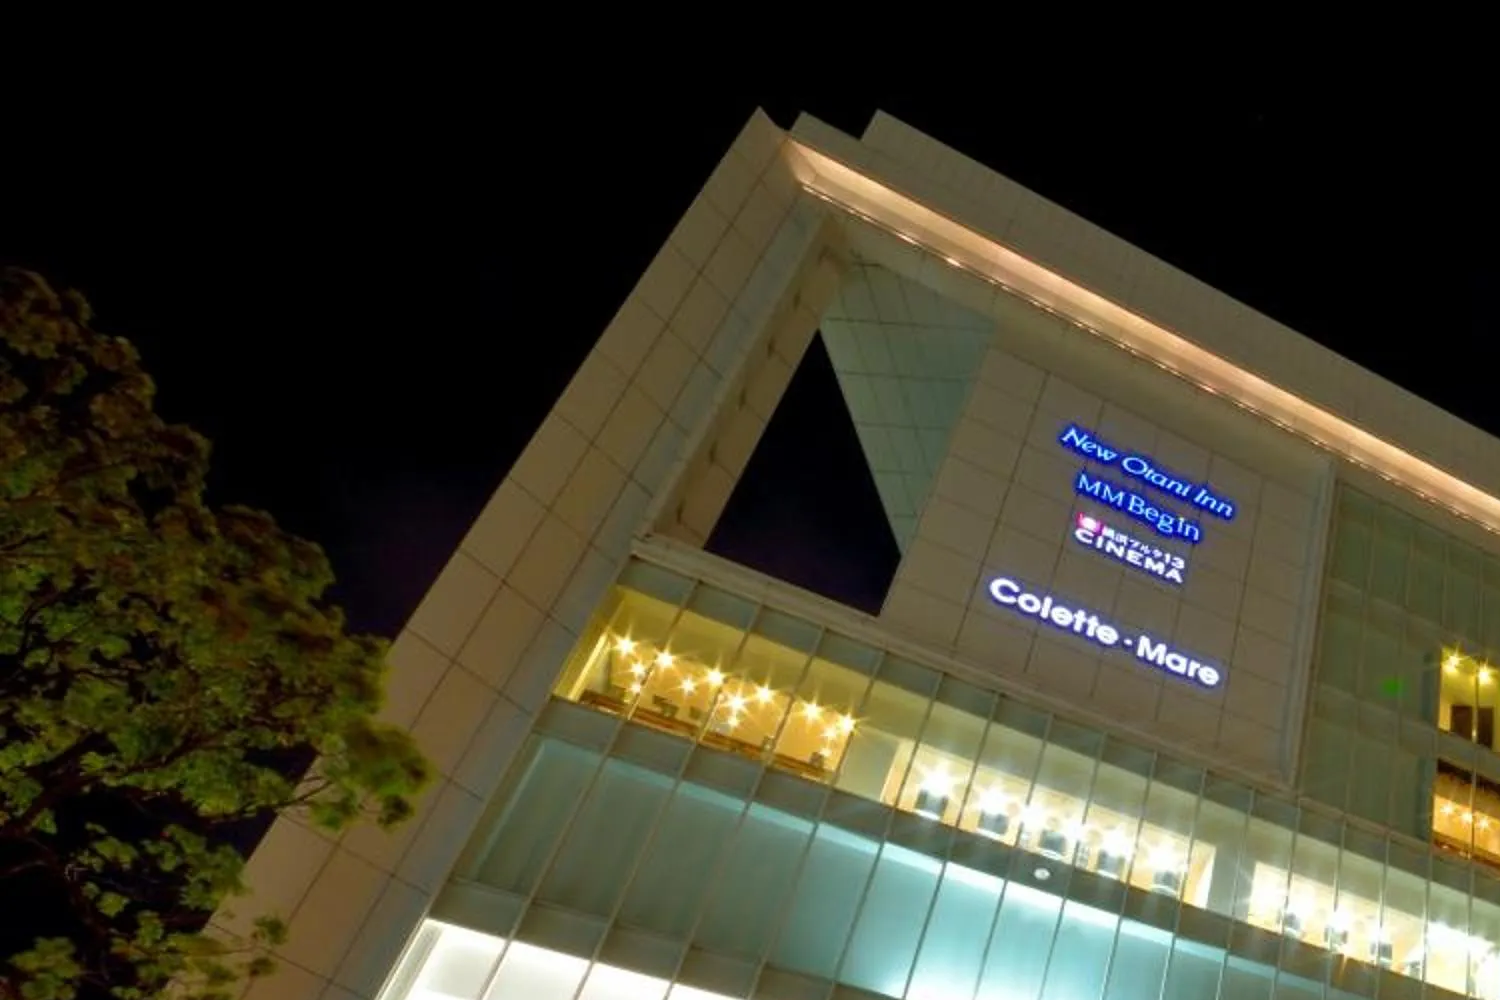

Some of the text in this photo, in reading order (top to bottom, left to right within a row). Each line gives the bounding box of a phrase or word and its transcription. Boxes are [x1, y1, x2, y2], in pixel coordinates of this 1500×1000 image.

[1061, 427, 1235, 518] New Otani Inn
[1075, 527, 1183, 584] CINEMA
